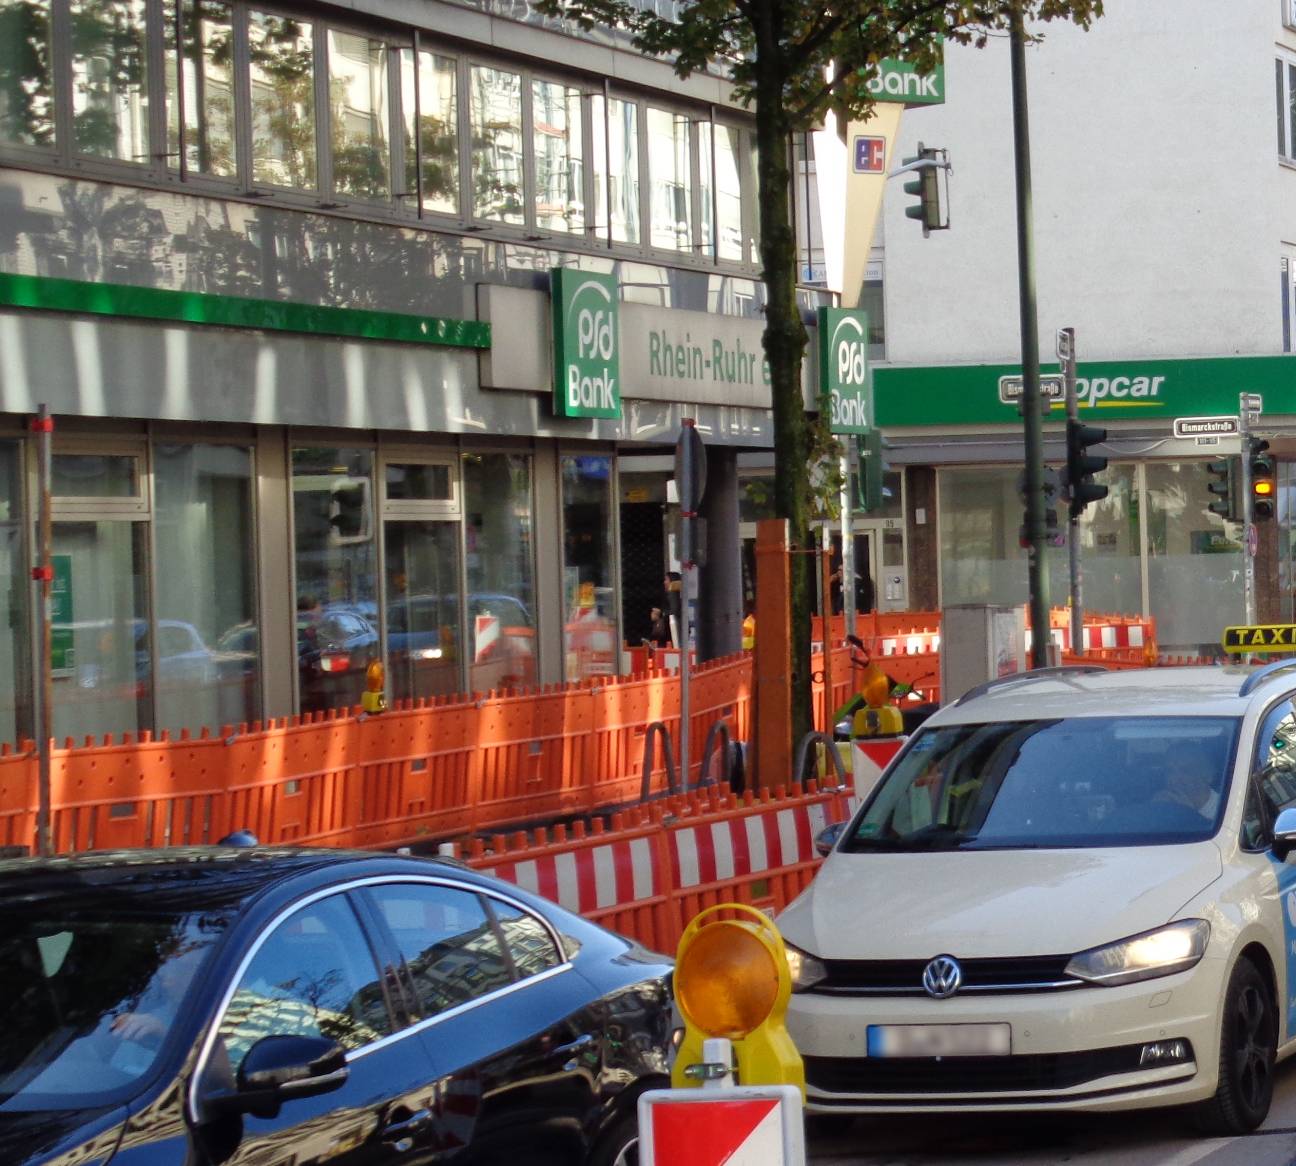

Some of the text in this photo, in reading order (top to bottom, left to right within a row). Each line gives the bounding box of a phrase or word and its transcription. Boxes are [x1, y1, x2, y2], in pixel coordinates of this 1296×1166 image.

[649, 331, 756, 384] Rhein-Ruhr
[568, 364, 616, 410] Bank
[1070, 375, 1165, 408] opcar
[1181, 421, 1233, 433] Bismarckstraße
[1236, 628, 1296, 645] TAXI
